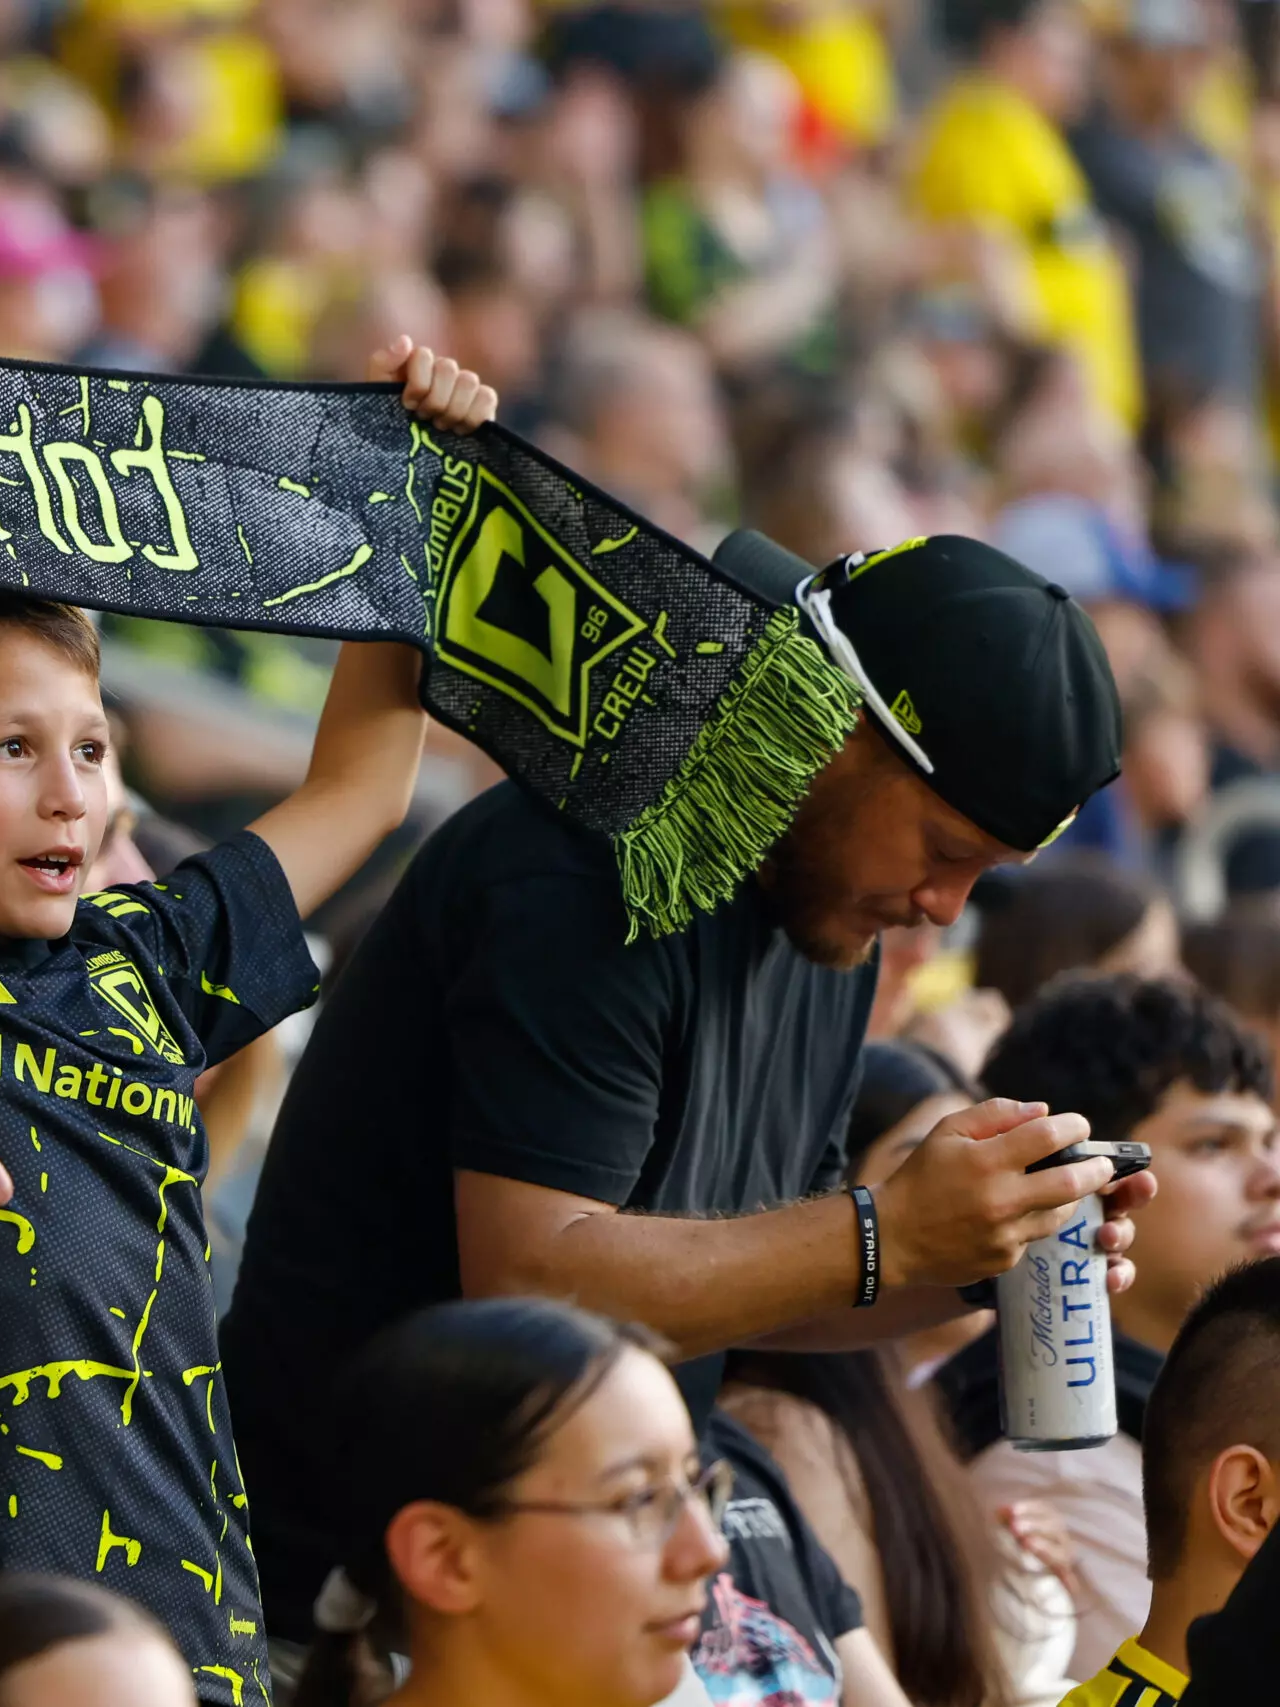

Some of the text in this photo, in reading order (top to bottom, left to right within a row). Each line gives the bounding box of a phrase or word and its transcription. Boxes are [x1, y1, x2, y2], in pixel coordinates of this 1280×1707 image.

[581, 605, 609, 643] 96
[594, 646, 656, 740] CREW
[13, 1042, 196, 1135] Nationw
[863, 1217, 876, 1272] STAND
[1031, 1256, 1058, 1367] Michelob
[1058, 1218, 1097, 1388] ULTRA
